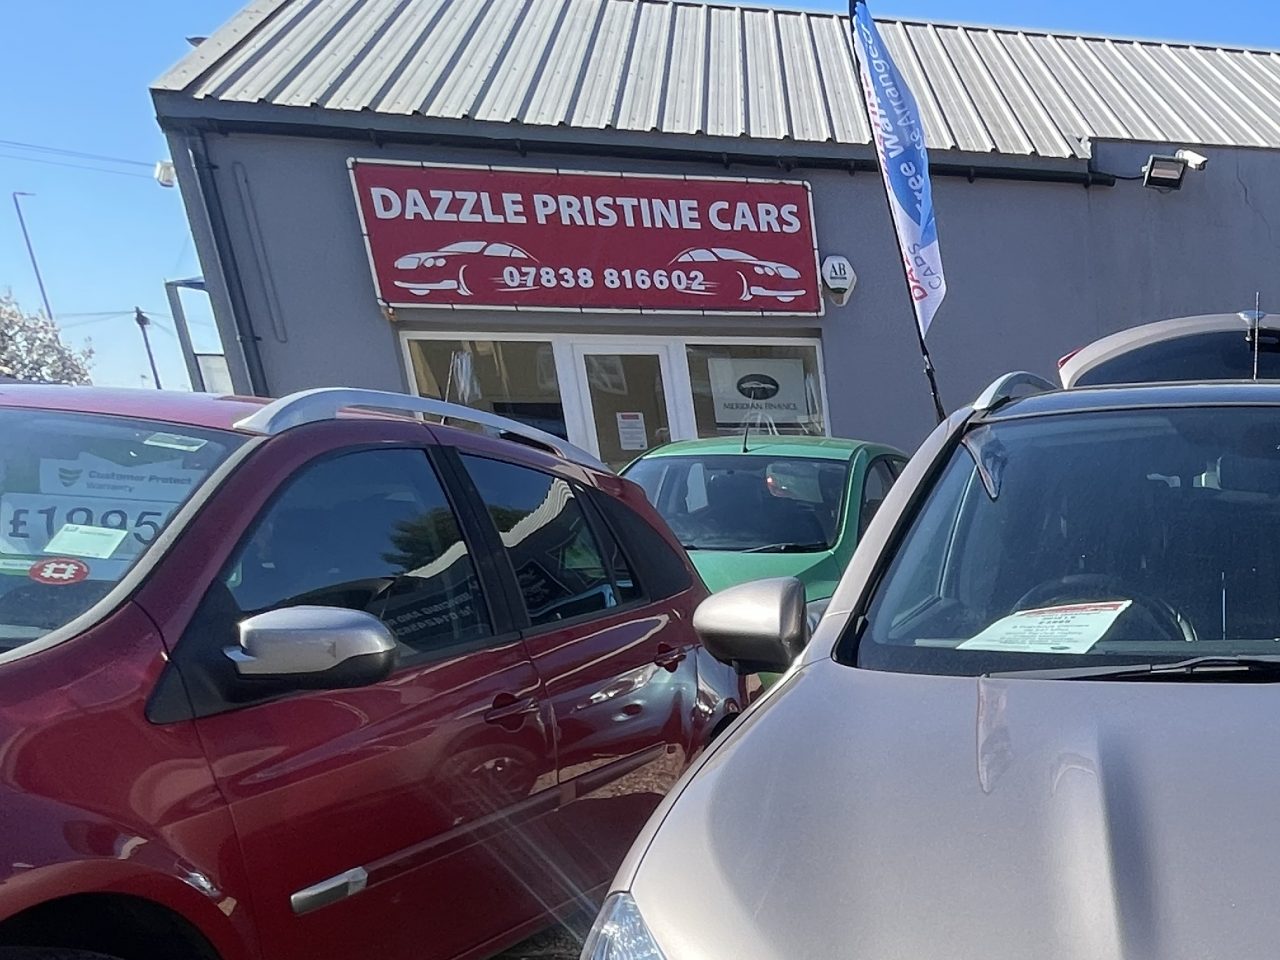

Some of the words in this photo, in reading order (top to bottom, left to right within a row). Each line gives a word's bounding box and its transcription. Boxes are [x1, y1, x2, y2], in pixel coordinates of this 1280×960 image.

[370, 187, 527, 224] DAZZLE
[533, 194, 701, 230] PRISTINE
[708, 200, 801, 234] CARS
[503, 266, 594, 288] 07838
[604, 268, 706, 290] 816602
[830, 262, 847, 276] AB
